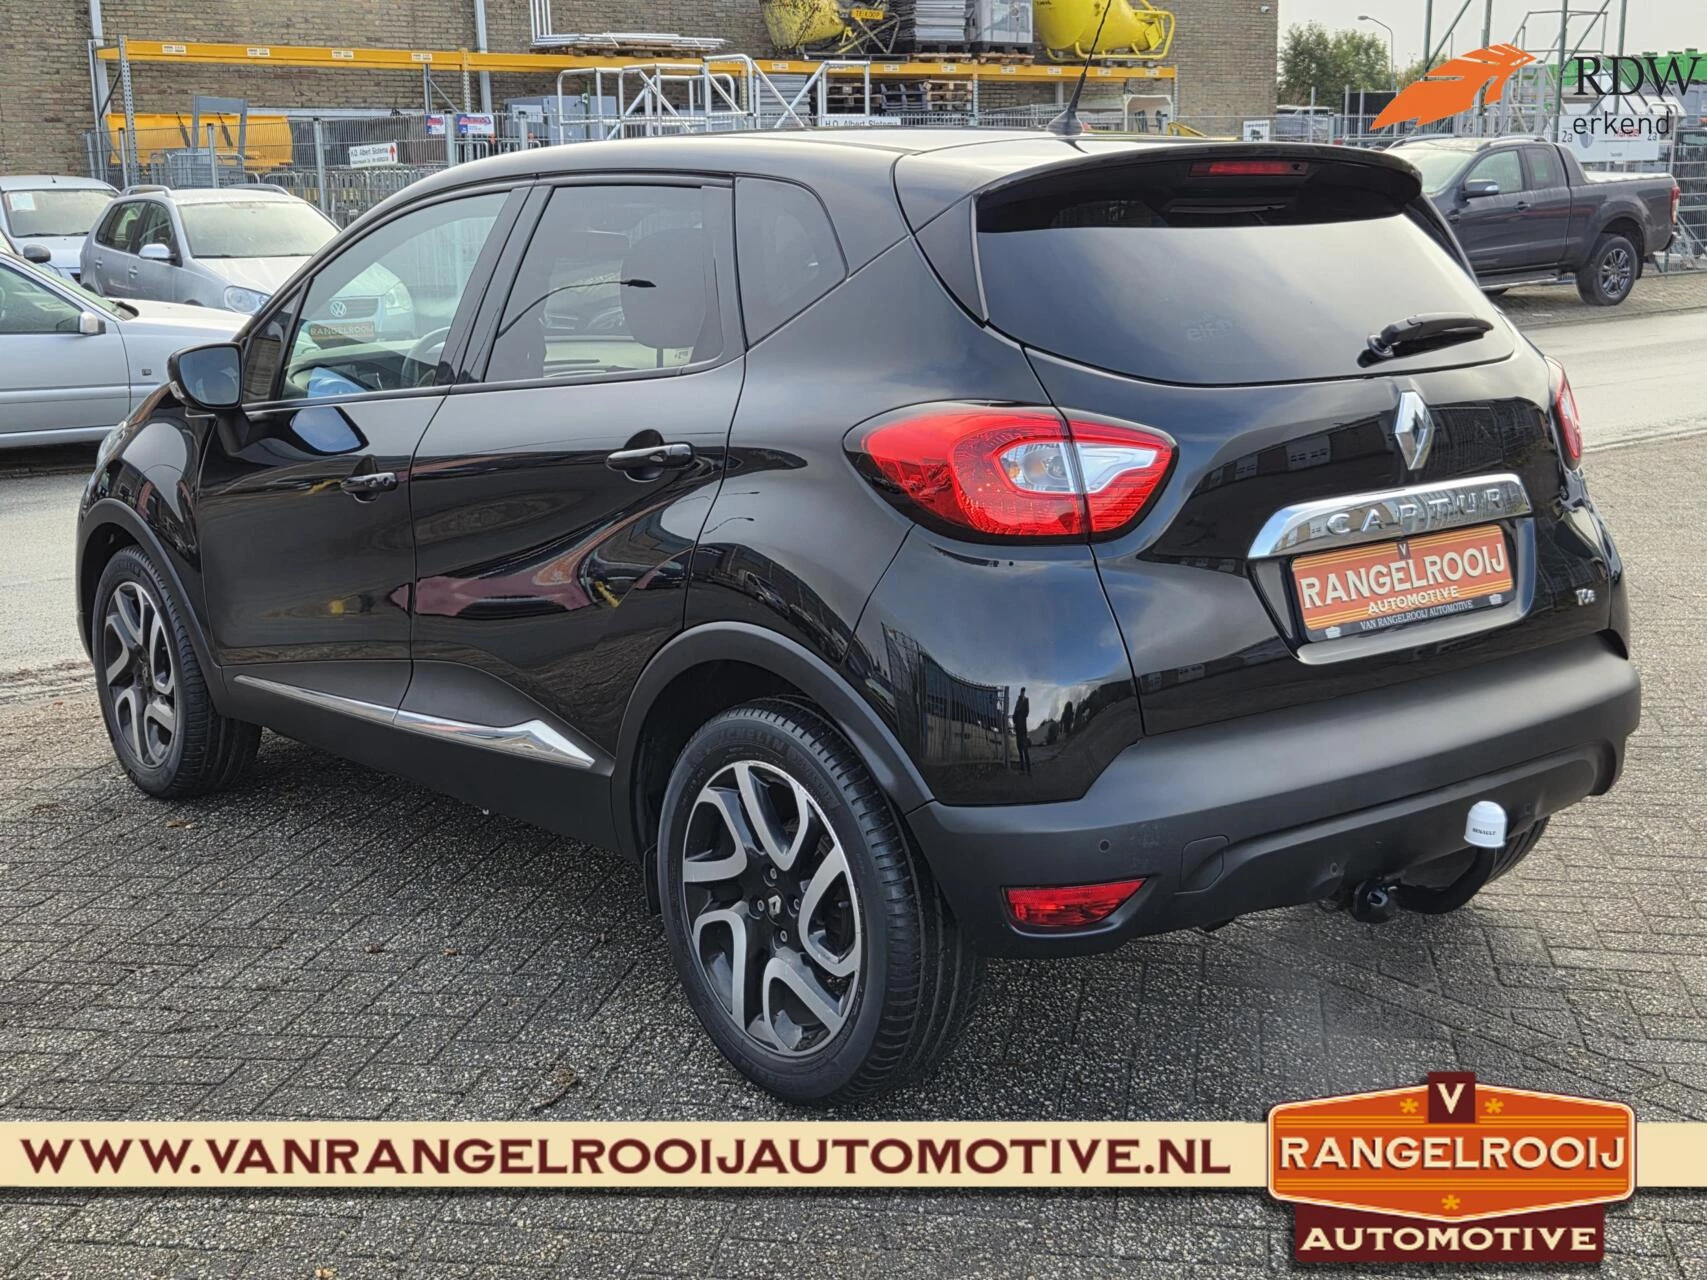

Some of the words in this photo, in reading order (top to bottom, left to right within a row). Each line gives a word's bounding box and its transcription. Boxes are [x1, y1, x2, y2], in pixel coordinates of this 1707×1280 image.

[1561, 130, 1573, 143] 2a
[1326, 488, 1502, 535] CAPTUR
[1398, 543, 1408, 556] V
[1299, 544, 1506, 609] RANGELROOIJ
[1360, 618, 1377, 630] VAN
[1377, 608, 1429, 627] RANGELROOIJ
[1428, 600, 1474, 618] AUTOMOTIVE
[1367, 585, 1461, 615] AUTOMOTIVE
